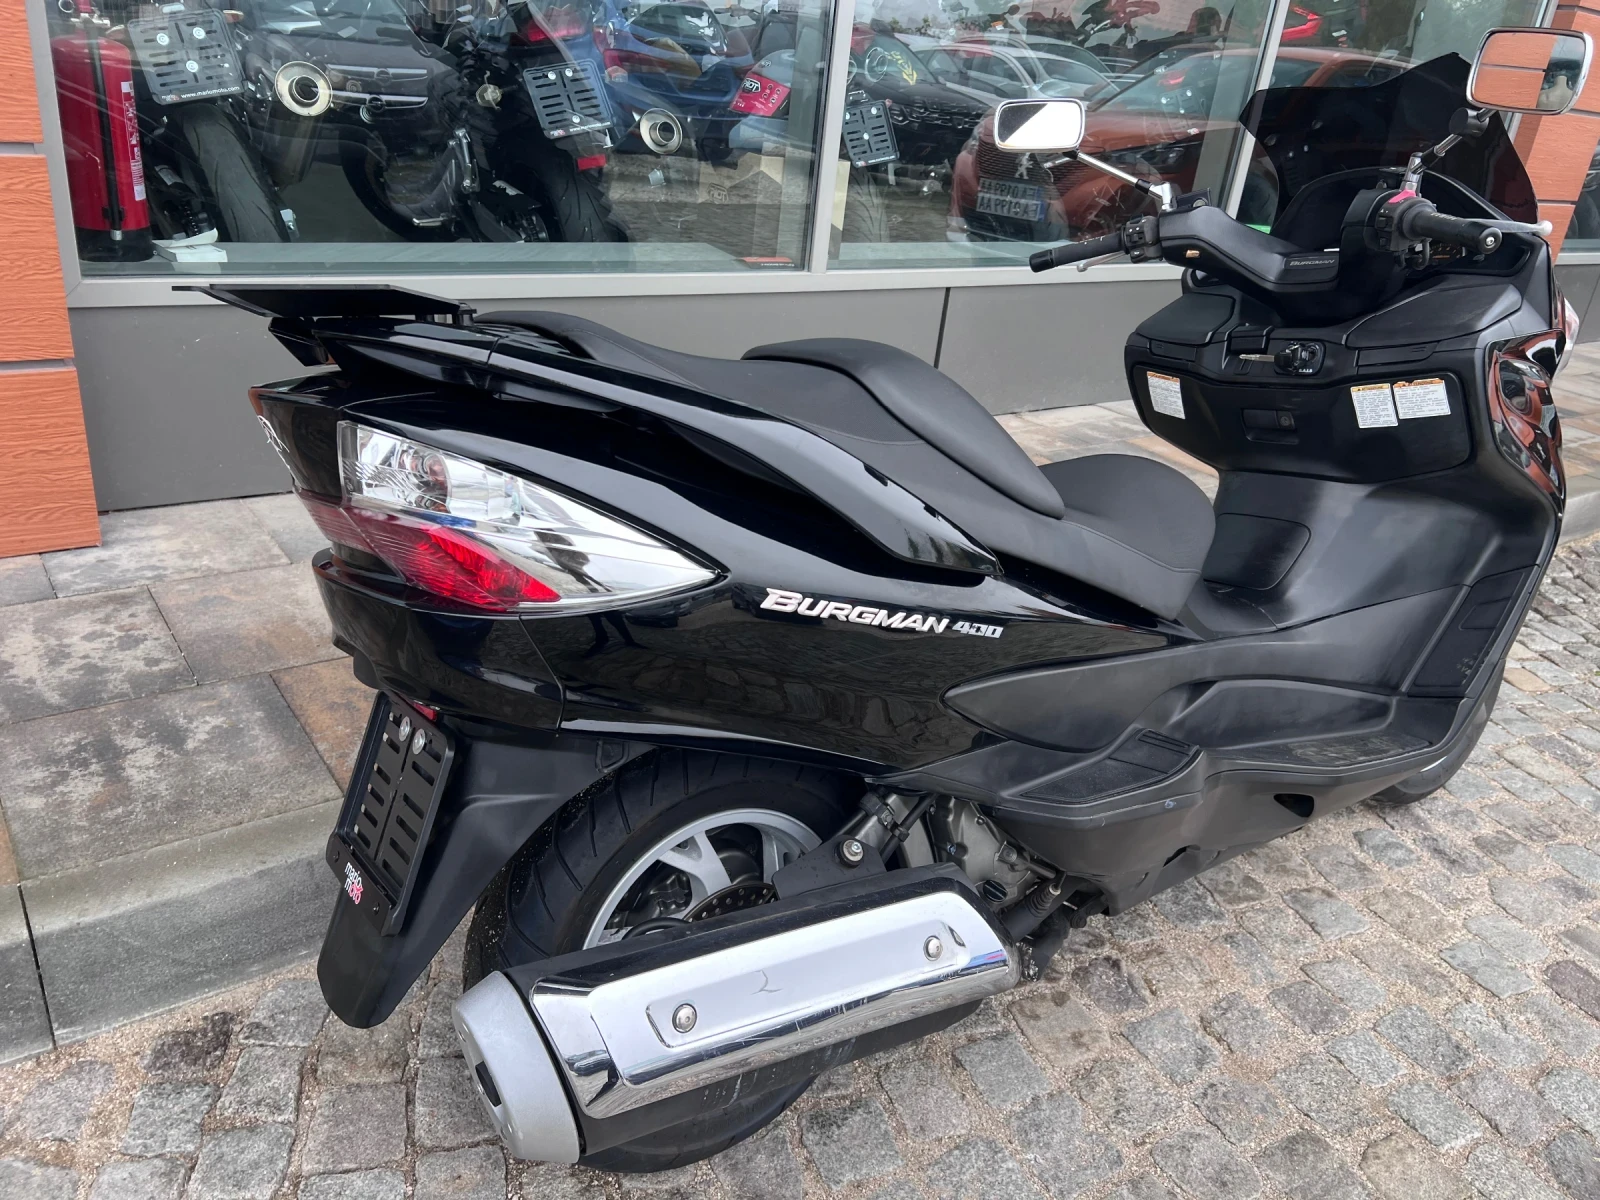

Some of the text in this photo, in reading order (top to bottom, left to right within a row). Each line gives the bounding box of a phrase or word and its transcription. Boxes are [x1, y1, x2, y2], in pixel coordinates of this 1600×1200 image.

[760, 588, 1004, 639] BURGMAN 400
[344, 862, 361, 888] mario
[344, 878, 362, 904] moto
